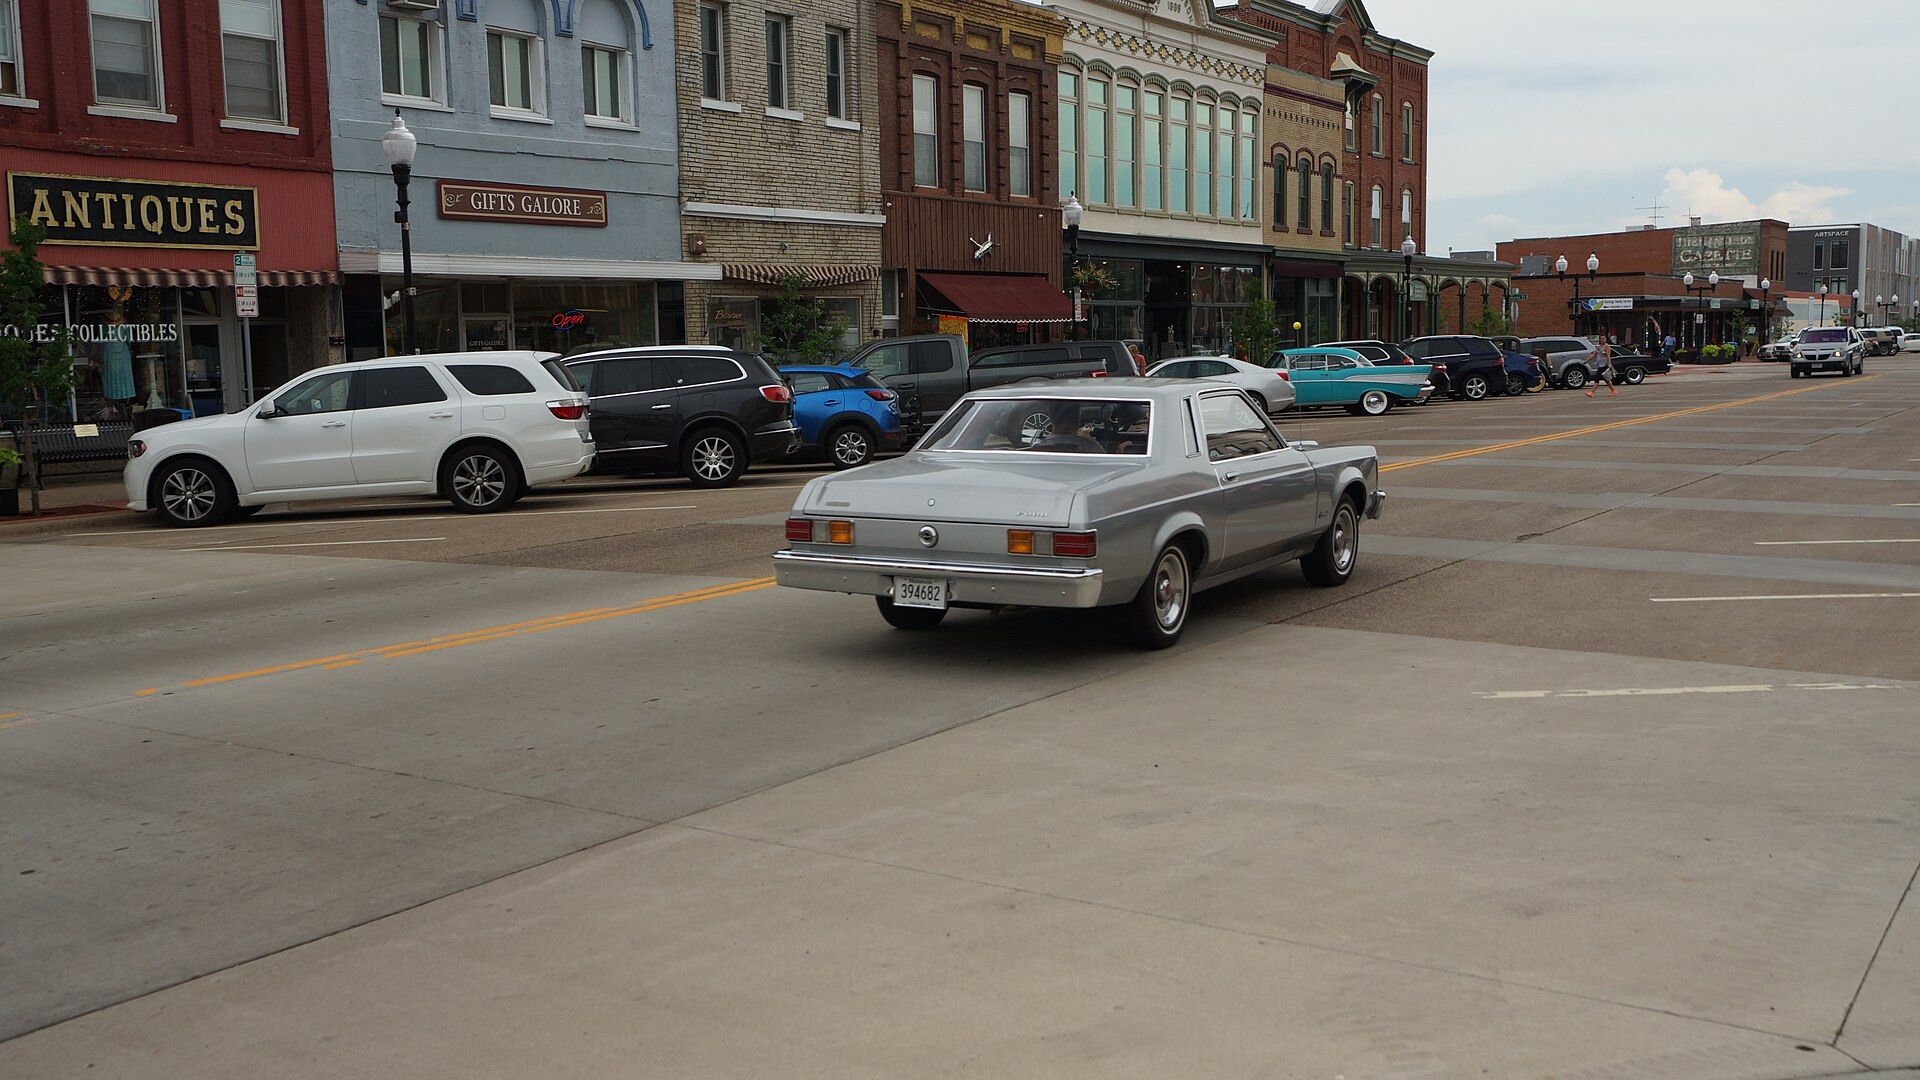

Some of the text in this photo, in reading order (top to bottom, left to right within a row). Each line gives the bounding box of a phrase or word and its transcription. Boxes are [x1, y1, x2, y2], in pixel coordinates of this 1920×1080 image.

[30, 189, 245, 235] ANTIQUES
[471, 192, 582, 215] GIFTS GALORE
[1814, 230, 1850, 238] ARTSPACE
[1680, 249, 1752, 262] GAZETTE
[552, 313, 584, 328] Open
[70, 324, 178, 343] COLLECTIBLES
[901, 584, 940, 601] 394682
